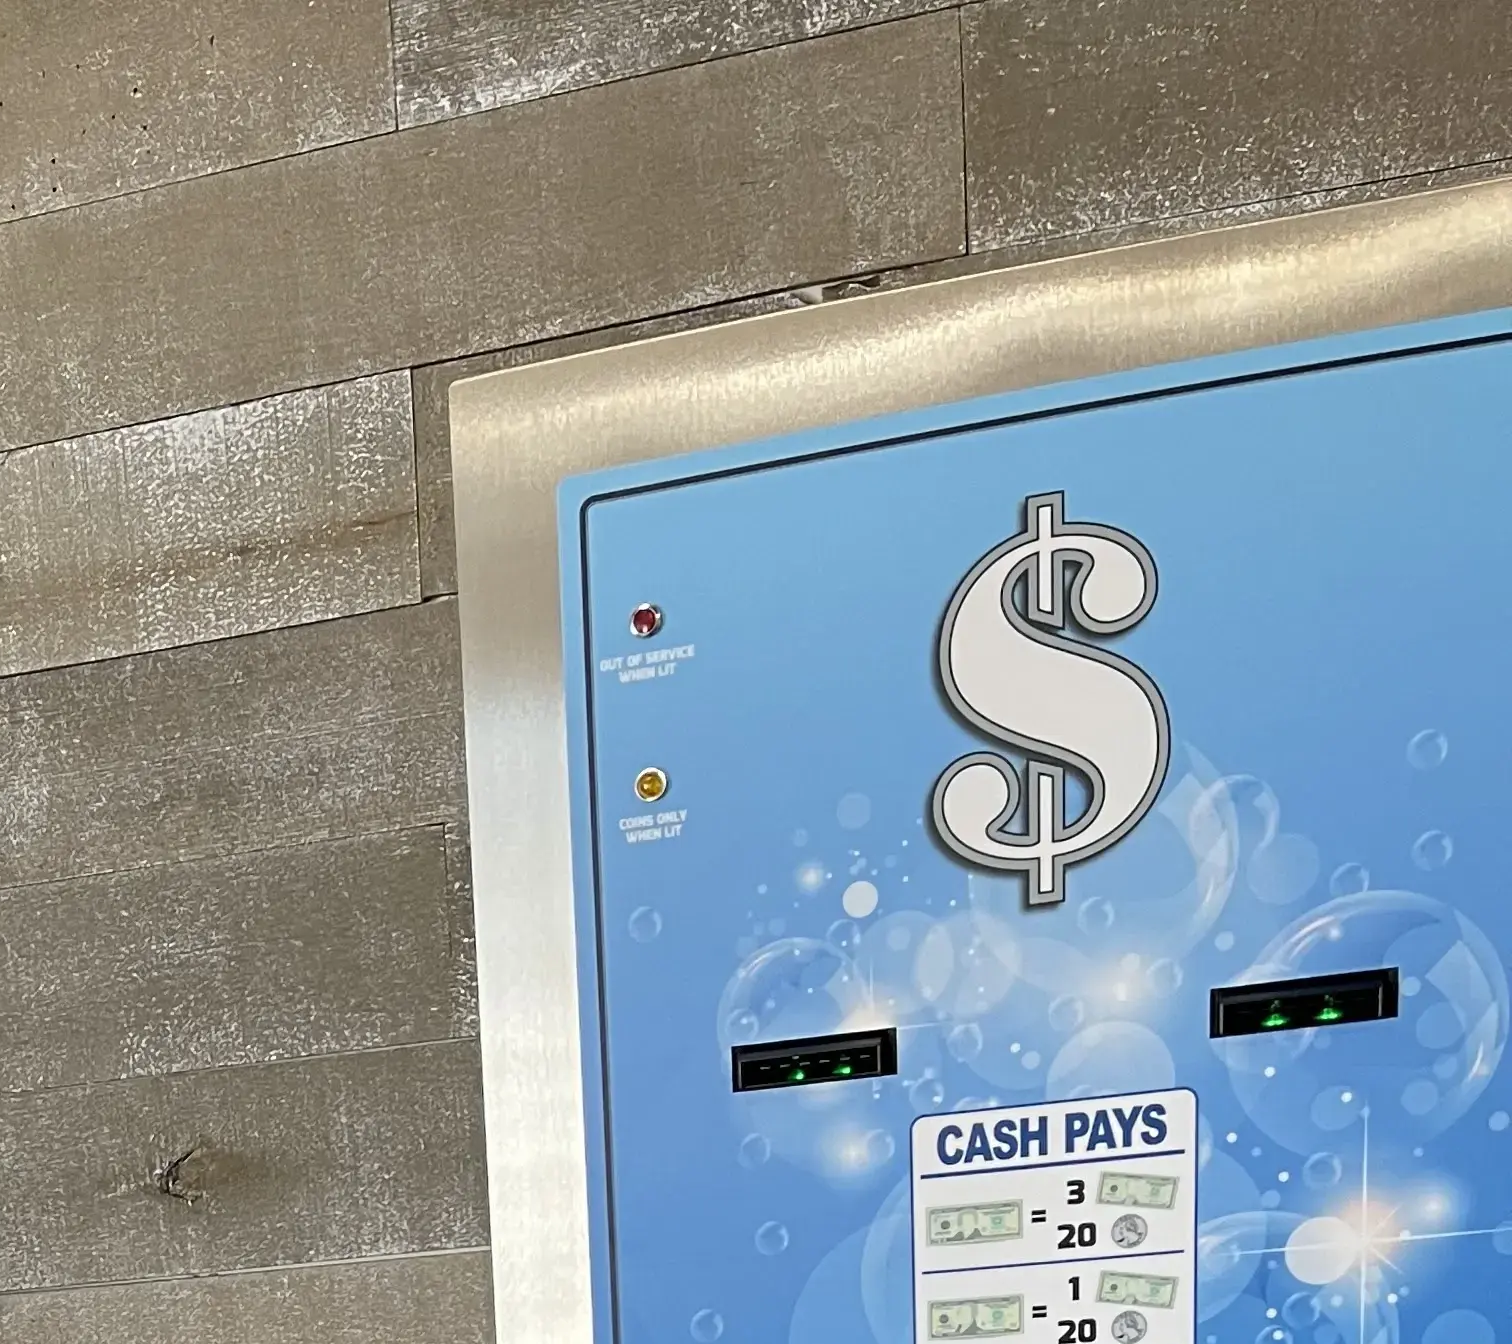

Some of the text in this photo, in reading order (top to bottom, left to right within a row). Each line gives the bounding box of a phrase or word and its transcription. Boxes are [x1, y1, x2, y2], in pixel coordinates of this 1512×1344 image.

[600, 644, 694, 671] OUT OF SERVICE
[619, 662, 677, 683] WHEN LIT
[619, 809, 687, 830] COINS ONLY
[626, 824, 682, 843] WHEN LIT
[937, 1103, 1167, 1165] CASH PAYS
[1066, 1180, 1085, 1204] 3
[1057, 1222, 1096, 1249] 20
[1068, 1276, 1080, 1301] 1
[1058, 1318, 1097, 1344] 20
